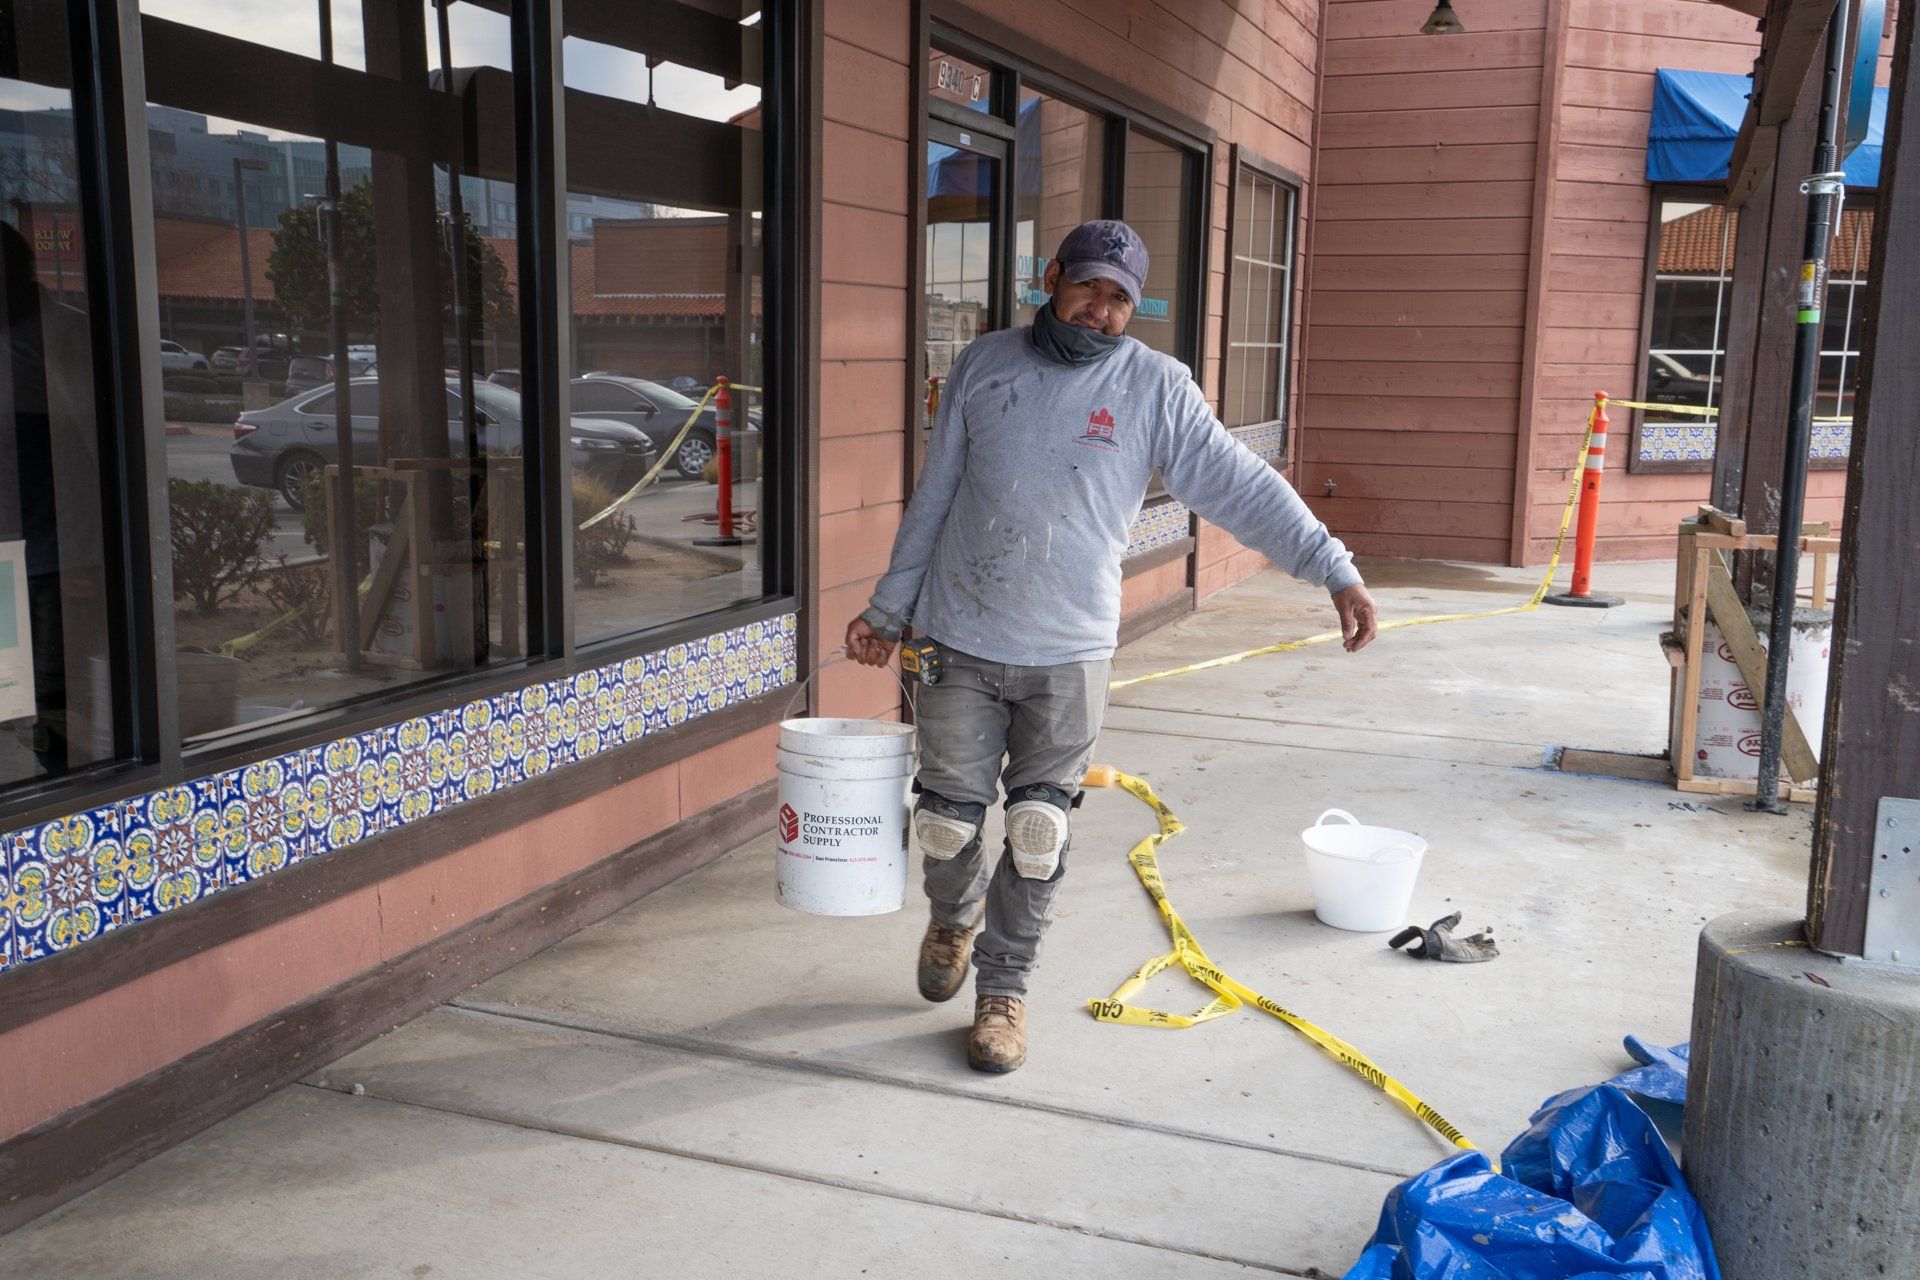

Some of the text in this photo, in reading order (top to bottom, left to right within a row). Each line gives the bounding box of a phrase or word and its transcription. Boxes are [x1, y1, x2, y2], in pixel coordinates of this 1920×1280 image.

[940, 62, 965, 94] 9340
[803, 812, 883, 826] PROFESSIONAL
[802, 823, 879, 837] CONTRACTOR
[803, 834, 842, 847] SUPPLY
